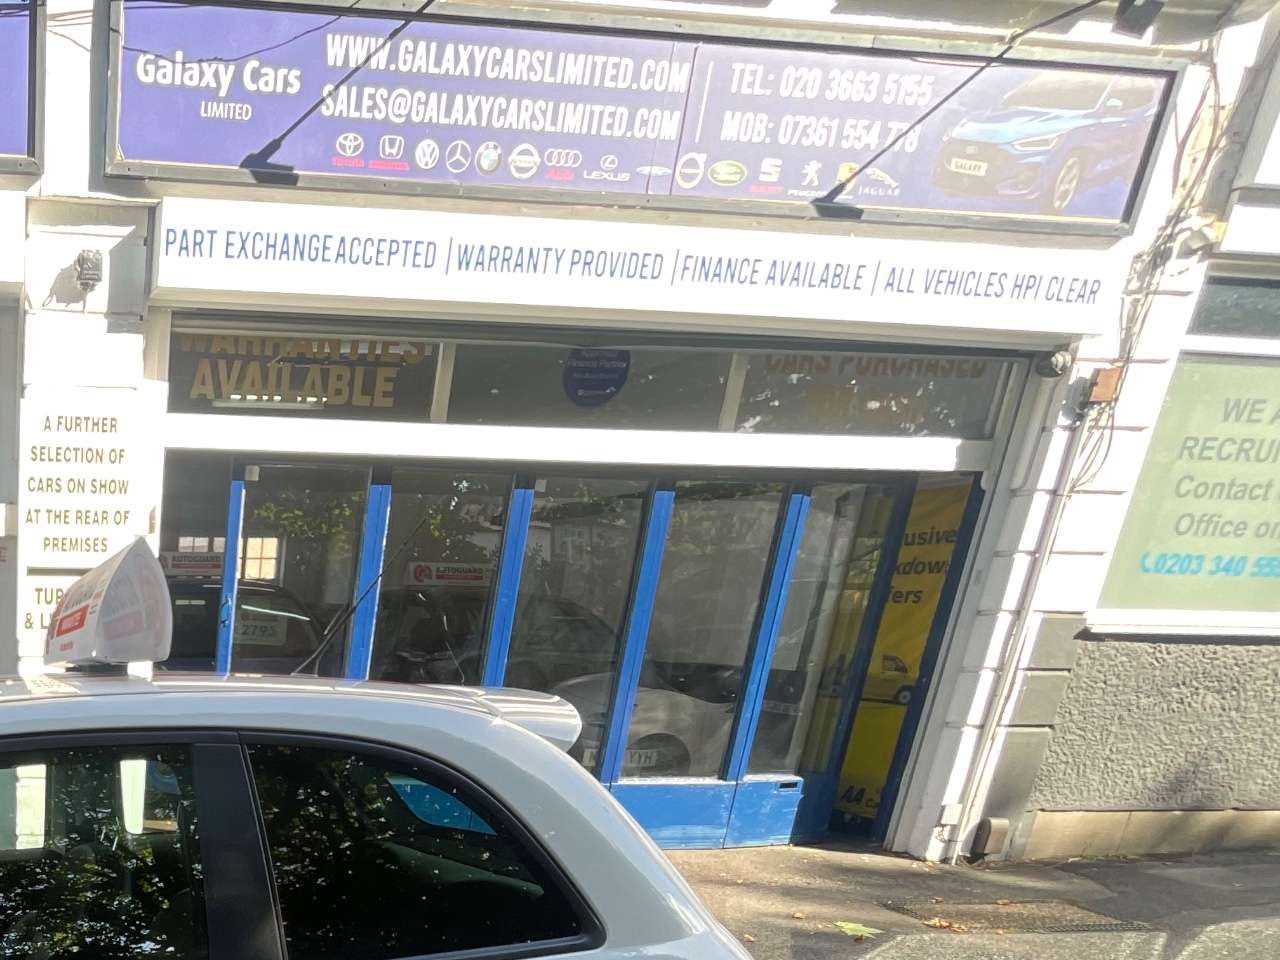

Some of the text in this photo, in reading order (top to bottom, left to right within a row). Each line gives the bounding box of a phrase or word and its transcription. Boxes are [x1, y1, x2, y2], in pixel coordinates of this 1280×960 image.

[136, 50, 302, 97] Galaxy Cars
[326, 33, 691, 93] WWW.GALAXYCARSLIMITED.COM
[730, 62, 932, 105] TEL: 020 3663 5155
[200, 100, 252, 121] LIMITED
[321, 84, 681, 141] SALES@GALAXYCARSLIMITED.COM
[720, 109, 775, 144] MOB:
[777, 111, 838, 147] 07361
[839, 117, 880, 149] 554
[165, 228, 1102, 305] PART EXCHANGE ACCEPTED WARRANTY PROVIDED FINANCE AVAILABLE ALL VEHICLES HPI CLEAR
[190, 359, 402, 409] AVAILABLE
[1221, 398, 1267, 424] WE
[43, 415, 118, 433] A FURTHER
[30, 446, 126, 464] SELECTION OF
[28, 477, 129, 495] CARS ON SHOW
[1174, 475, 1276, 501] Contact
[25, 509, 131, 526] AT THE REAR OF
[1174, 513, 1249, 538] Office
[43, 537, 108, 552] PREMISES
[902, 526, 959, 546] usive
[24, 613, 34, 629] &
